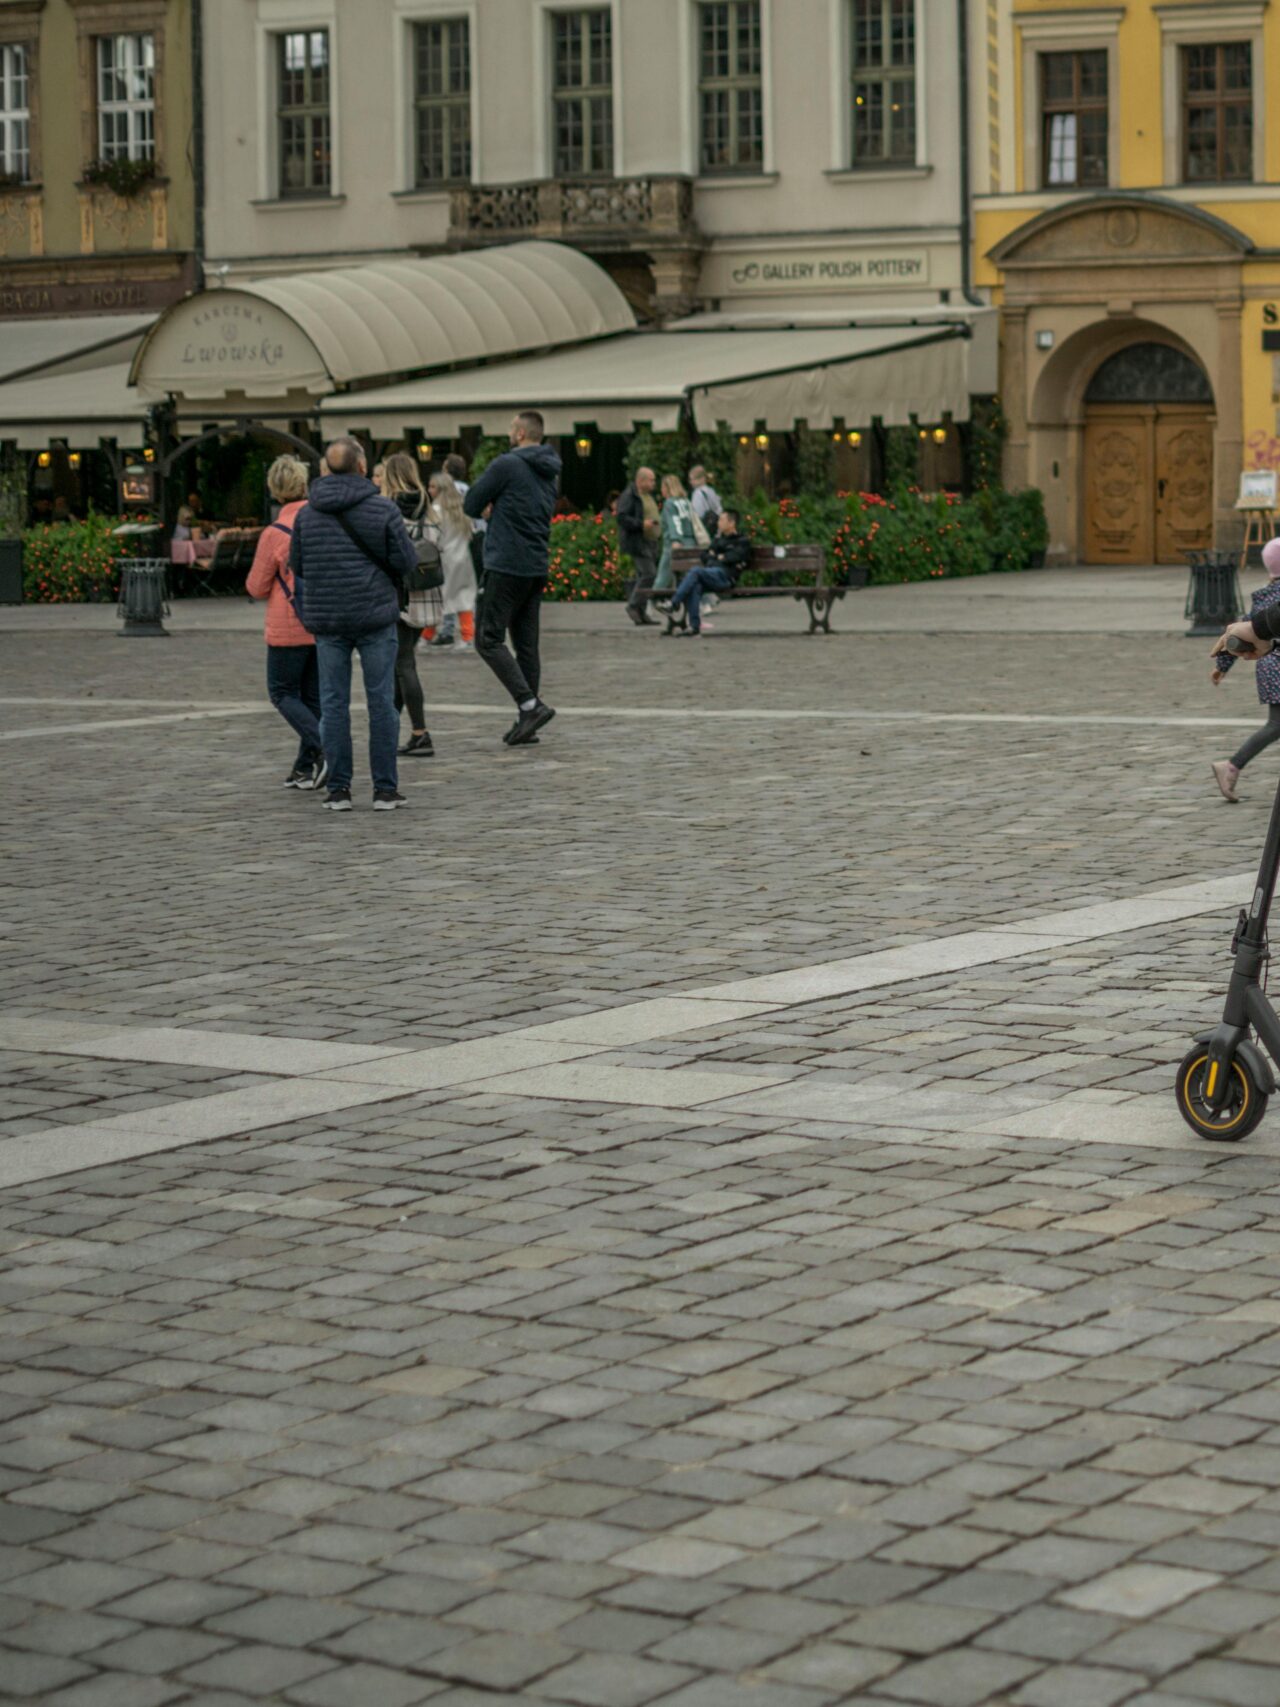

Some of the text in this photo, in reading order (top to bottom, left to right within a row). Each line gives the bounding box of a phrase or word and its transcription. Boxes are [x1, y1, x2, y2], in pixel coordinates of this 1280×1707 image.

[761, 258, 923, 281] GALLERY POLISH POTTERY
[89, 285, 147, 305] HOTEL
[181, 338, 284, 367] Lwowska
